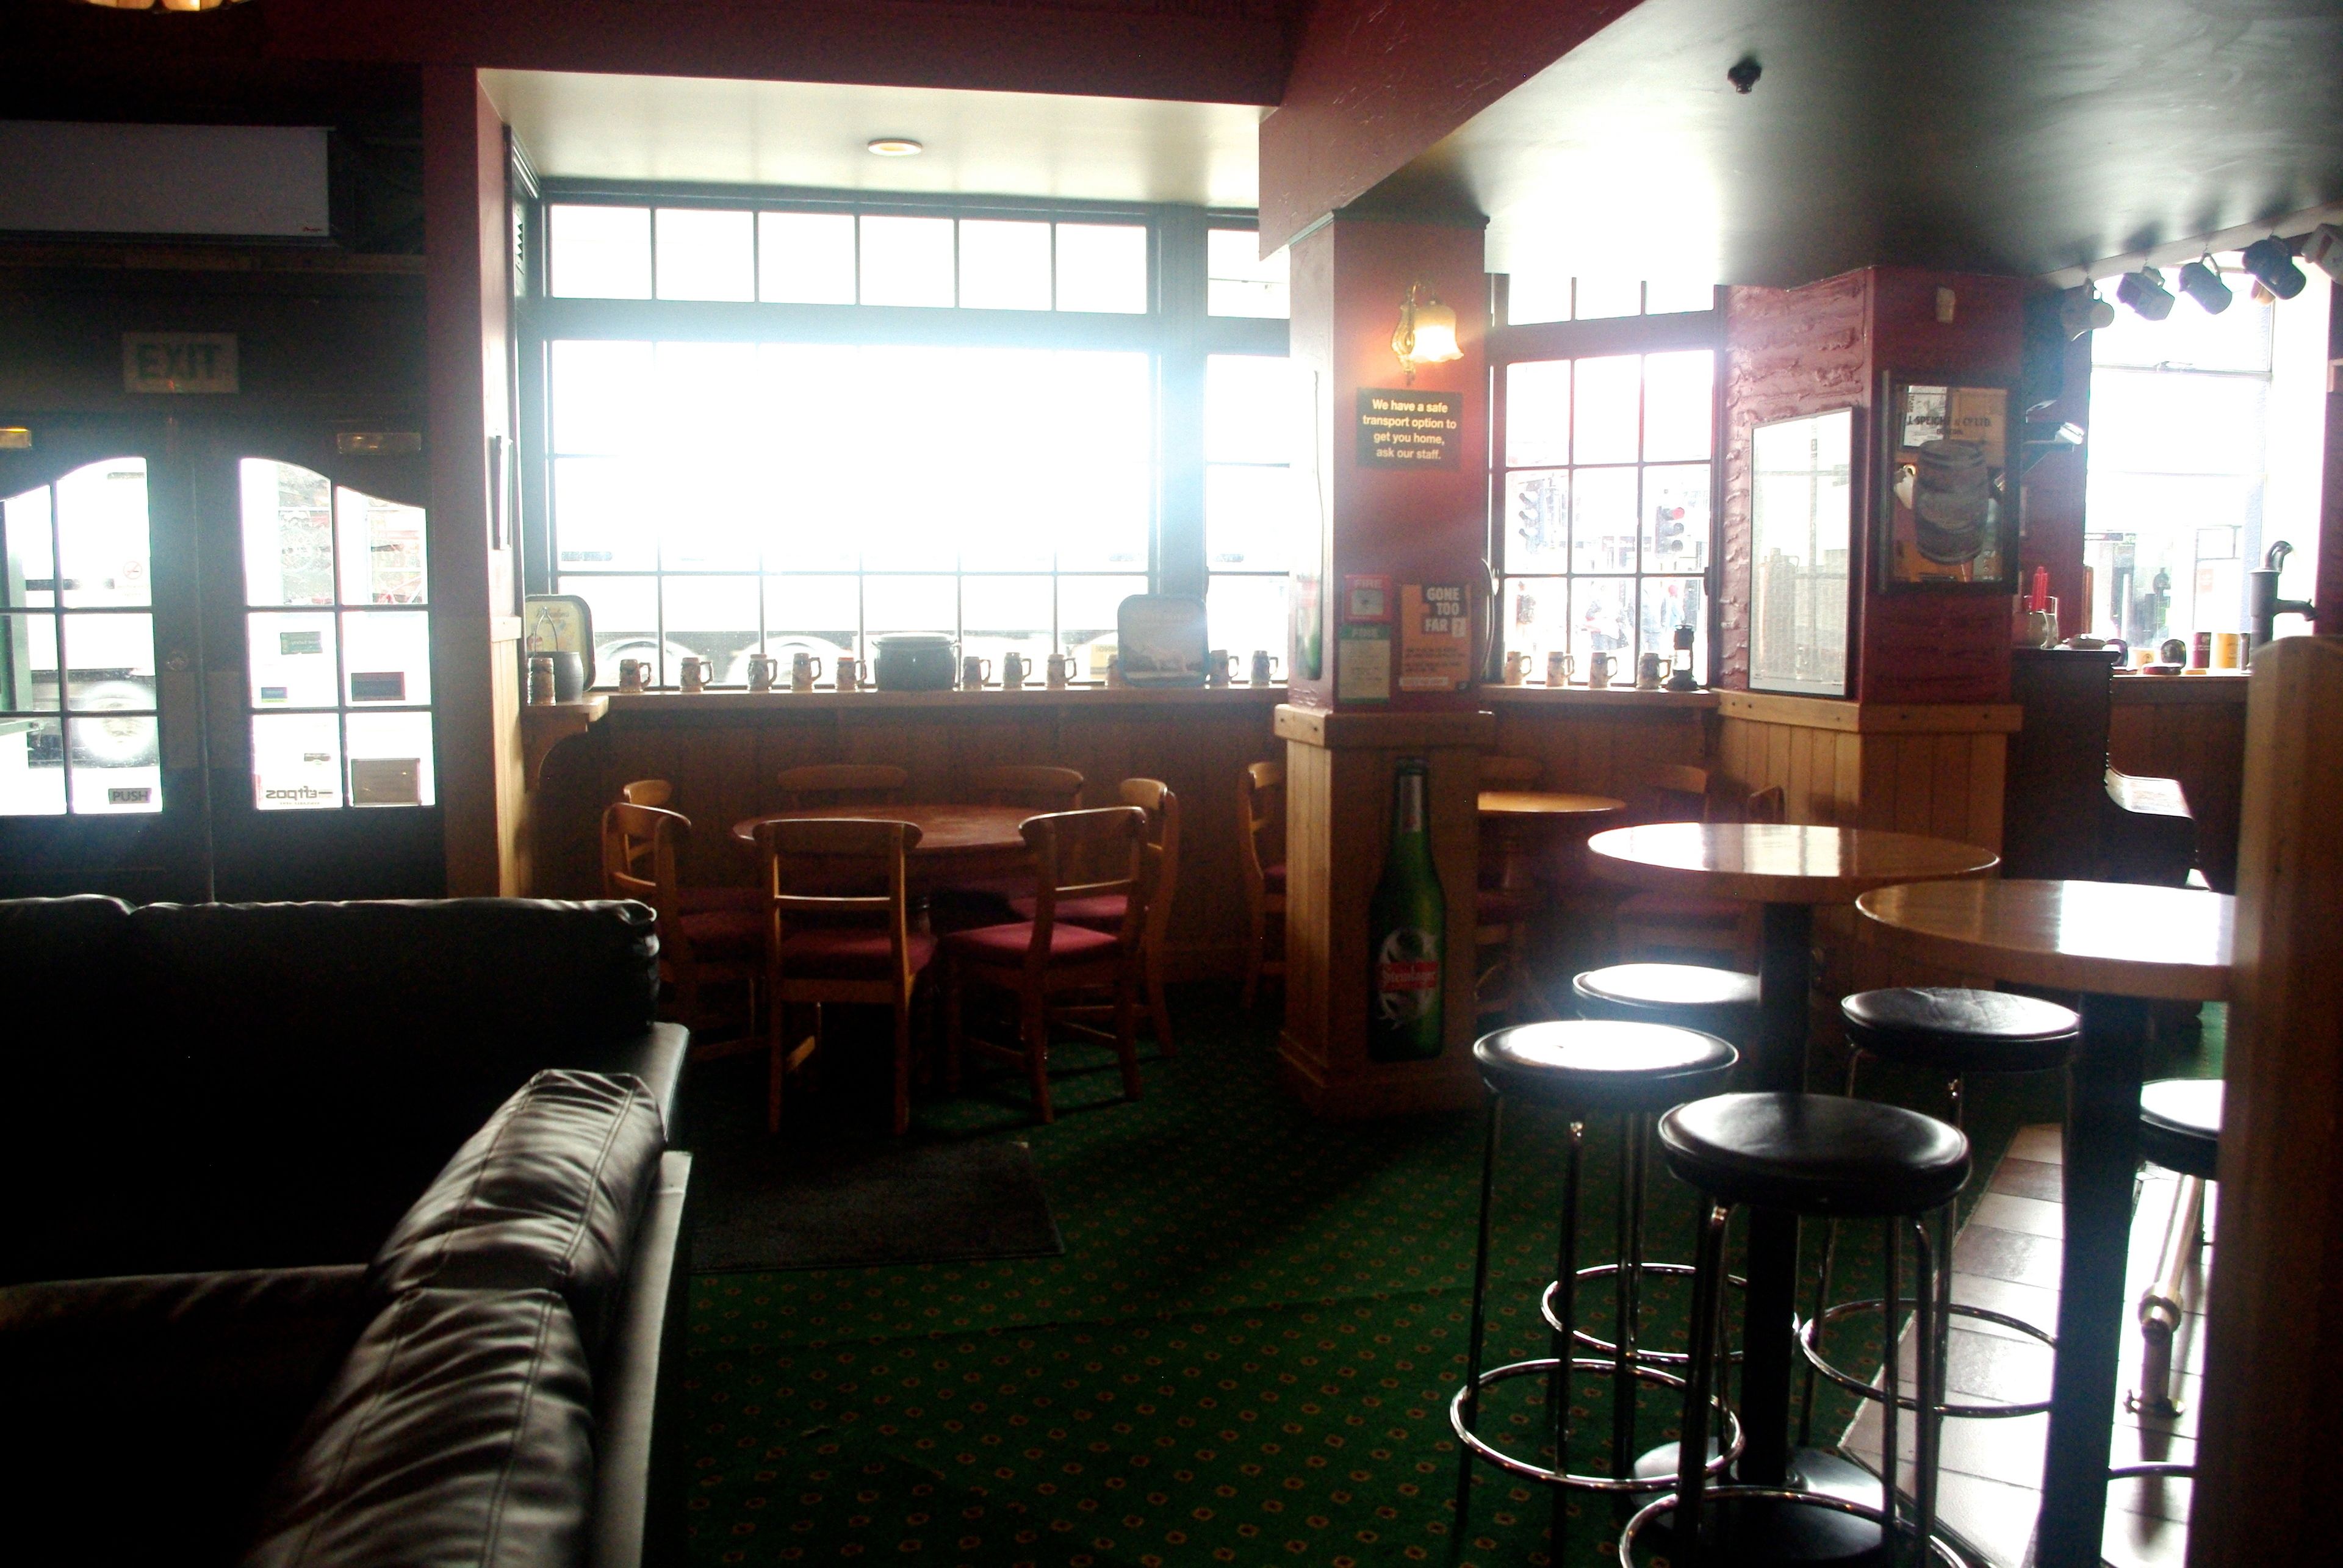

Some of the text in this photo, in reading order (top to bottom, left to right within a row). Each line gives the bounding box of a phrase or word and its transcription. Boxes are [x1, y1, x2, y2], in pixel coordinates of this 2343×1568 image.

[137, 343, 222, 379] EXIT
[1372, 398, 1449, 413] We have a safe
[1362, 415, 1457, 430] transport option to
[1373, 431, 1445, 446] get you home,
[1376, 447, 1441, 459] ask our staff.
[1354, 578, 1383, 588] FIRE
[1427, 587, 1459, 600] GONE
[1436, 602, 1459, 615] TOO
[1425, 617, 1448, 631] FAR
[113, 791, 148, 802] PUSH
